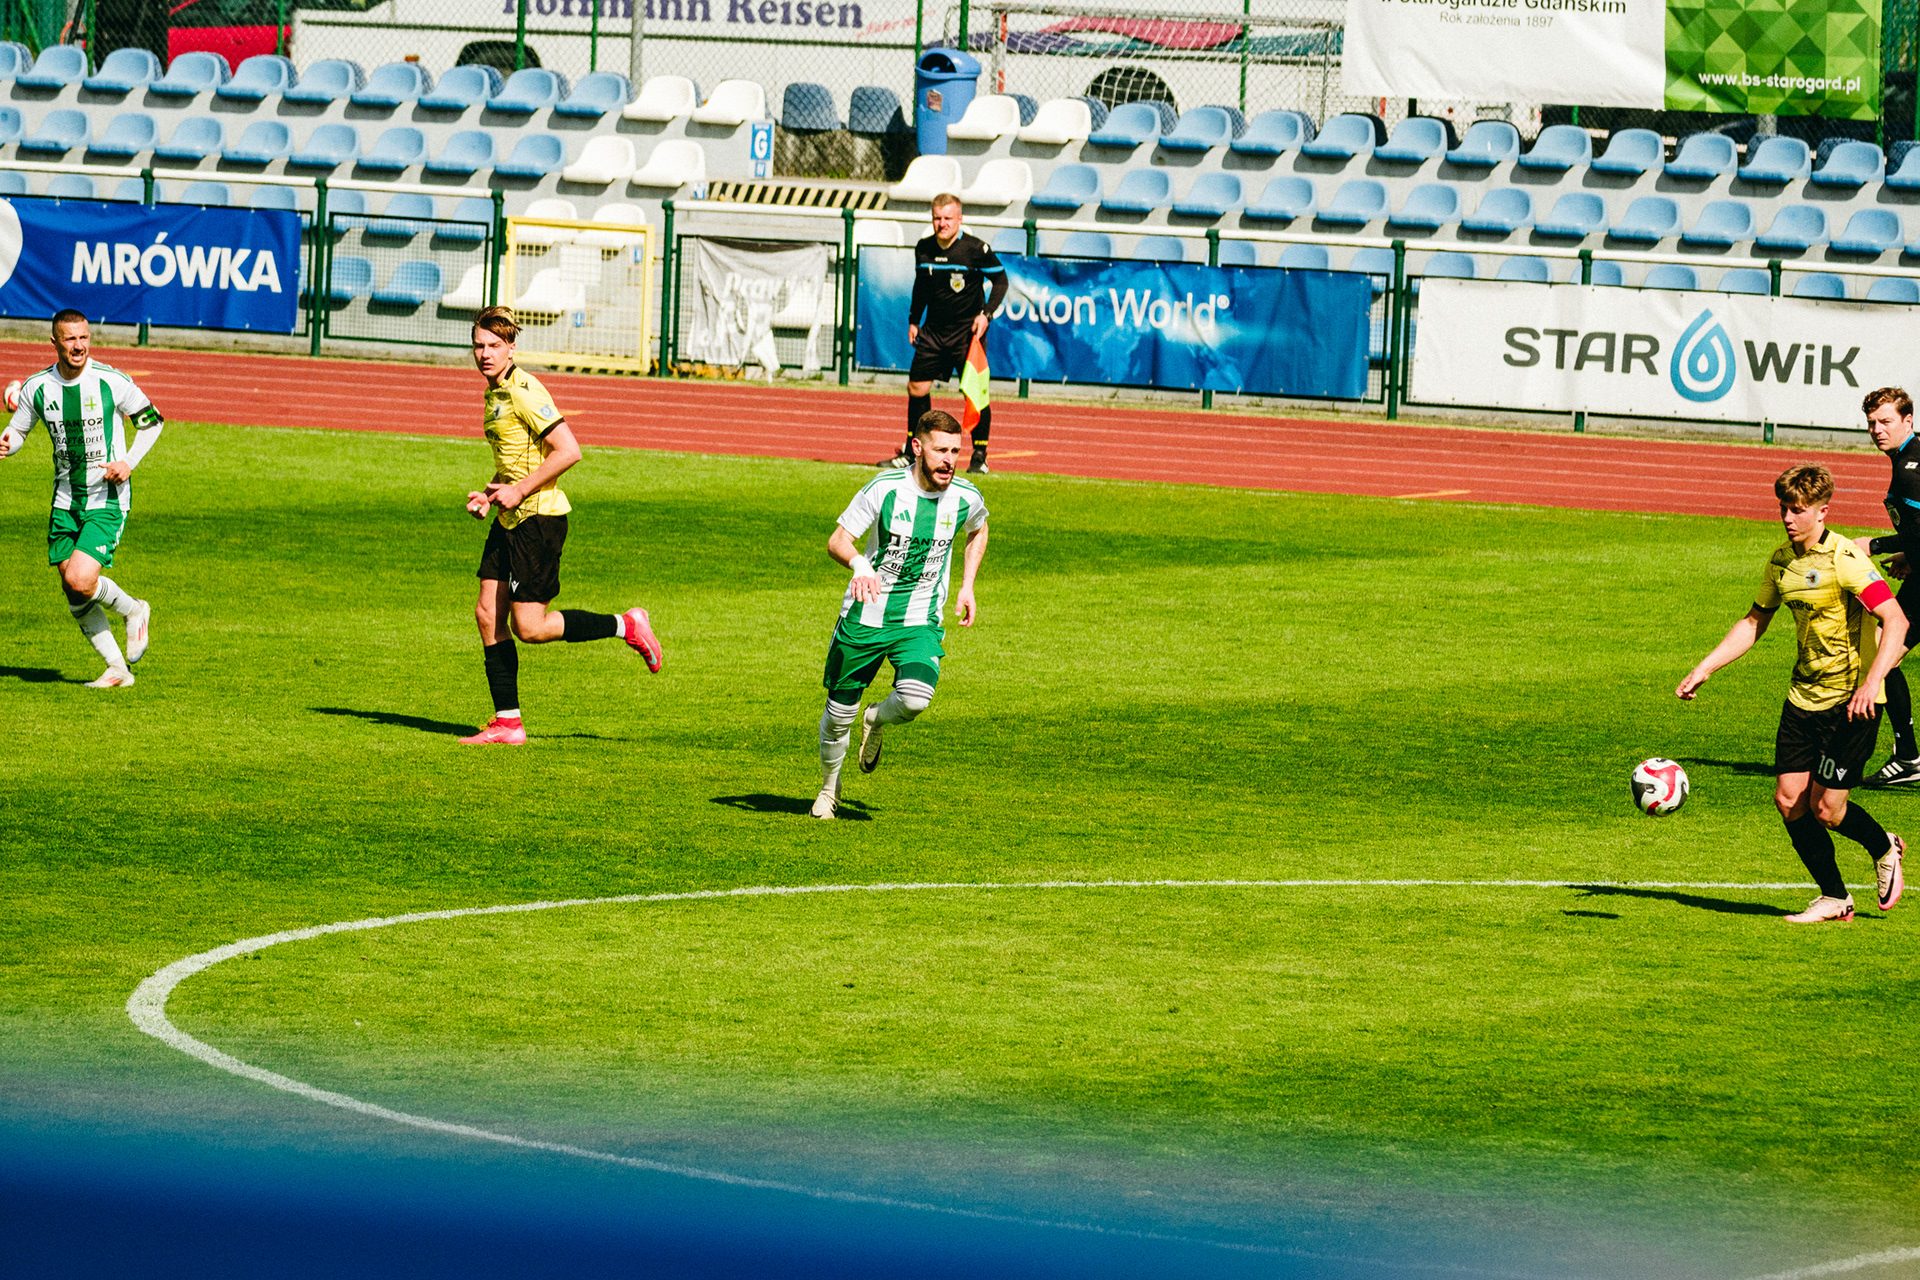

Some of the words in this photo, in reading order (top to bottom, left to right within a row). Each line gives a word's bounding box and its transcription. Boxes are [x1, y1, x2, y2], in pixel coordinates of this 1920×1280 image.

[727, 0, 863, 28] Reisen
[1440, 12, 1463, 24] Rok
[1466, 14, 1521, 27] założenia
[1526, 16, 1554, 28] 1897
[1698, 72, 1861, 95] www.bs-starogard.pl
[754, 130, 768, 159] G
[71, 231, 283, 293] MRÓWKA
[993, 285, 1097, 326] otton
[1503, 326, 1661, 376] STAR
[1744, 340, 1861, 388] WiK
[1817, 754, 1836, 780] 10
